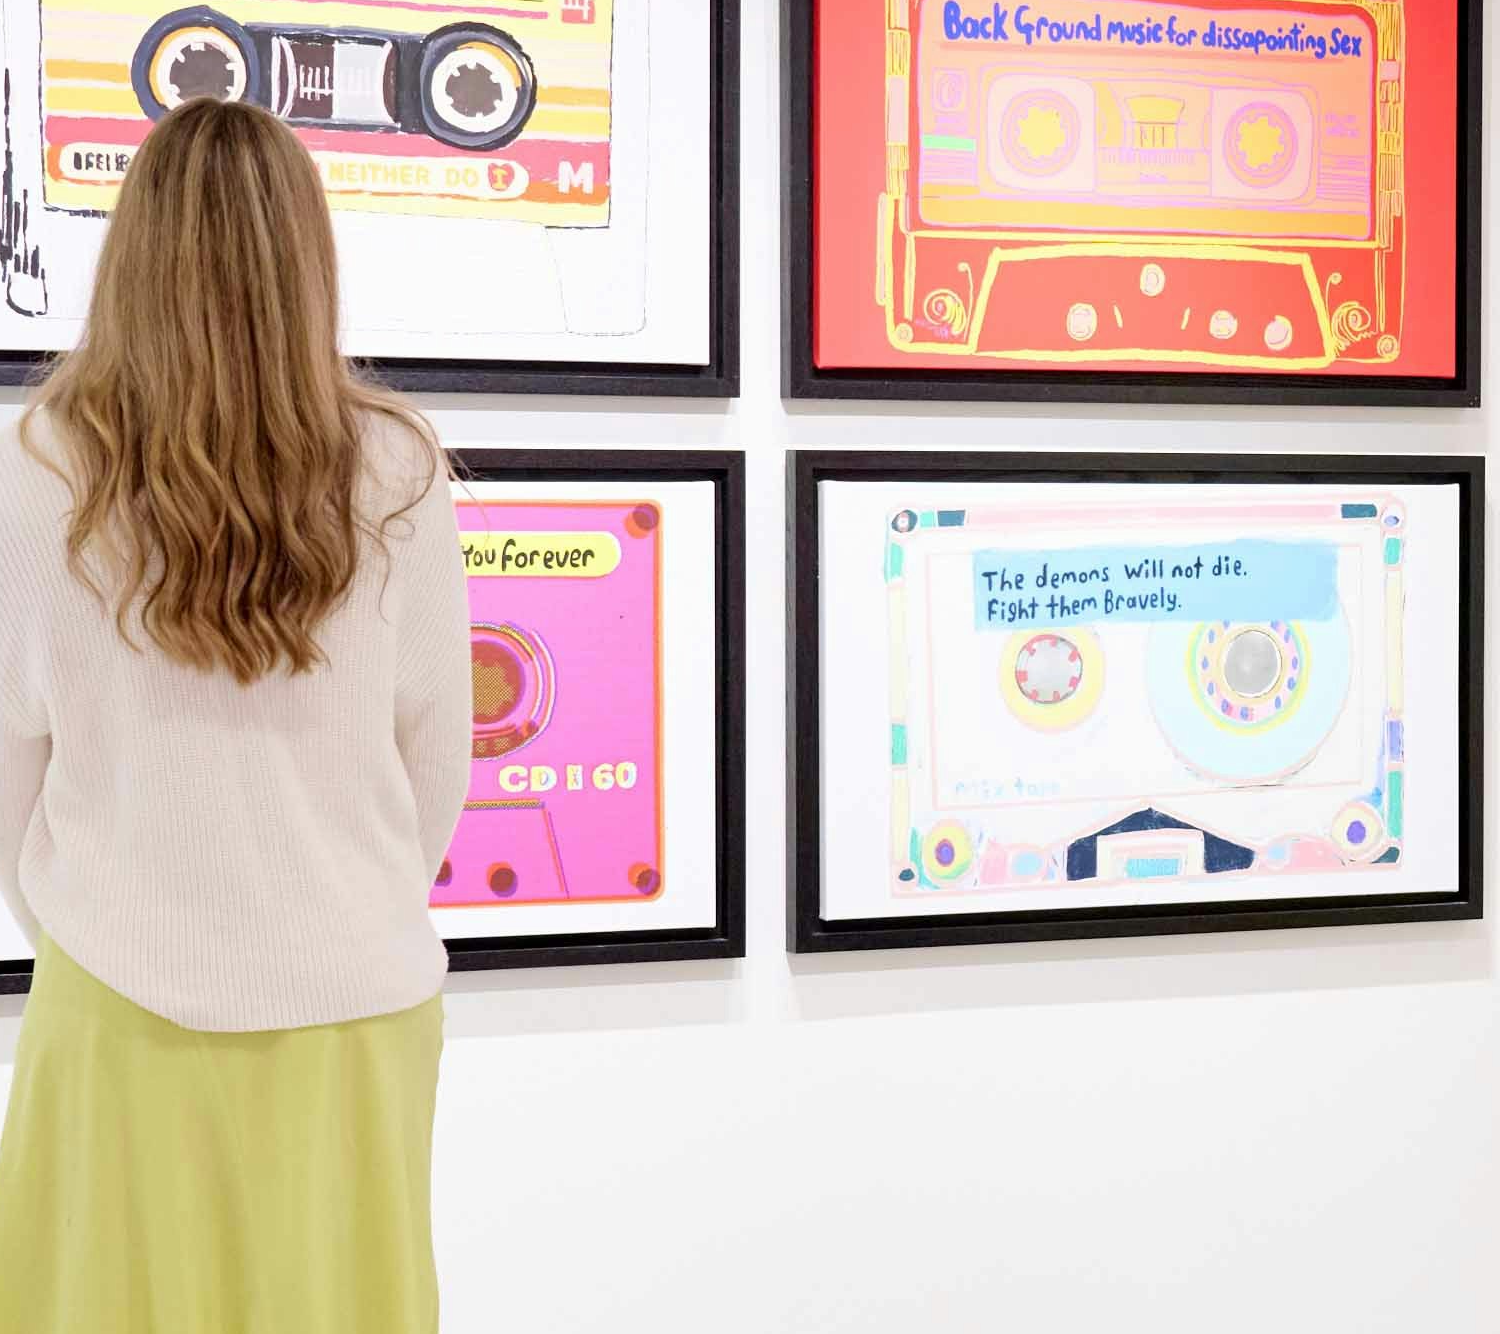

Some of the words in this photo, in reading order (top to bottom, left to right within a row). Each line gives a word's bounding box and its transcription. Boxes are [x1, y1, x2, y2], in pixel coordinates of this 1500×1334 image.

[943, 0, 1009, 42] Back
[1014, 4, 1101, 46] Ground
[1106, 17, 1163, 45] music
[1165, 15, 1198, 47] for
[1201, 19, 1328, 60] dissapointing
[1329, 27, 1363, 58] Sex
[328, 162, 429, 185] NEITHER
[445, 167, 479, 187] DO
[558, 161, 594, 194] M
[460, 544, 496, 569] You
[981, 568, 1025, 592] The
[1035, 562, 1109, 590] demons
[1171, 555, 1204, 580] not
[1212, 555, 1247, 577] die.
[987, 596, 1039, 623] Fight
[1045, 594, 1098, 620] them
[1104, 586, 1182, 615] Bravely.
[499, 765, 557, 793] CD
[592, 762, 637, 790] 60
